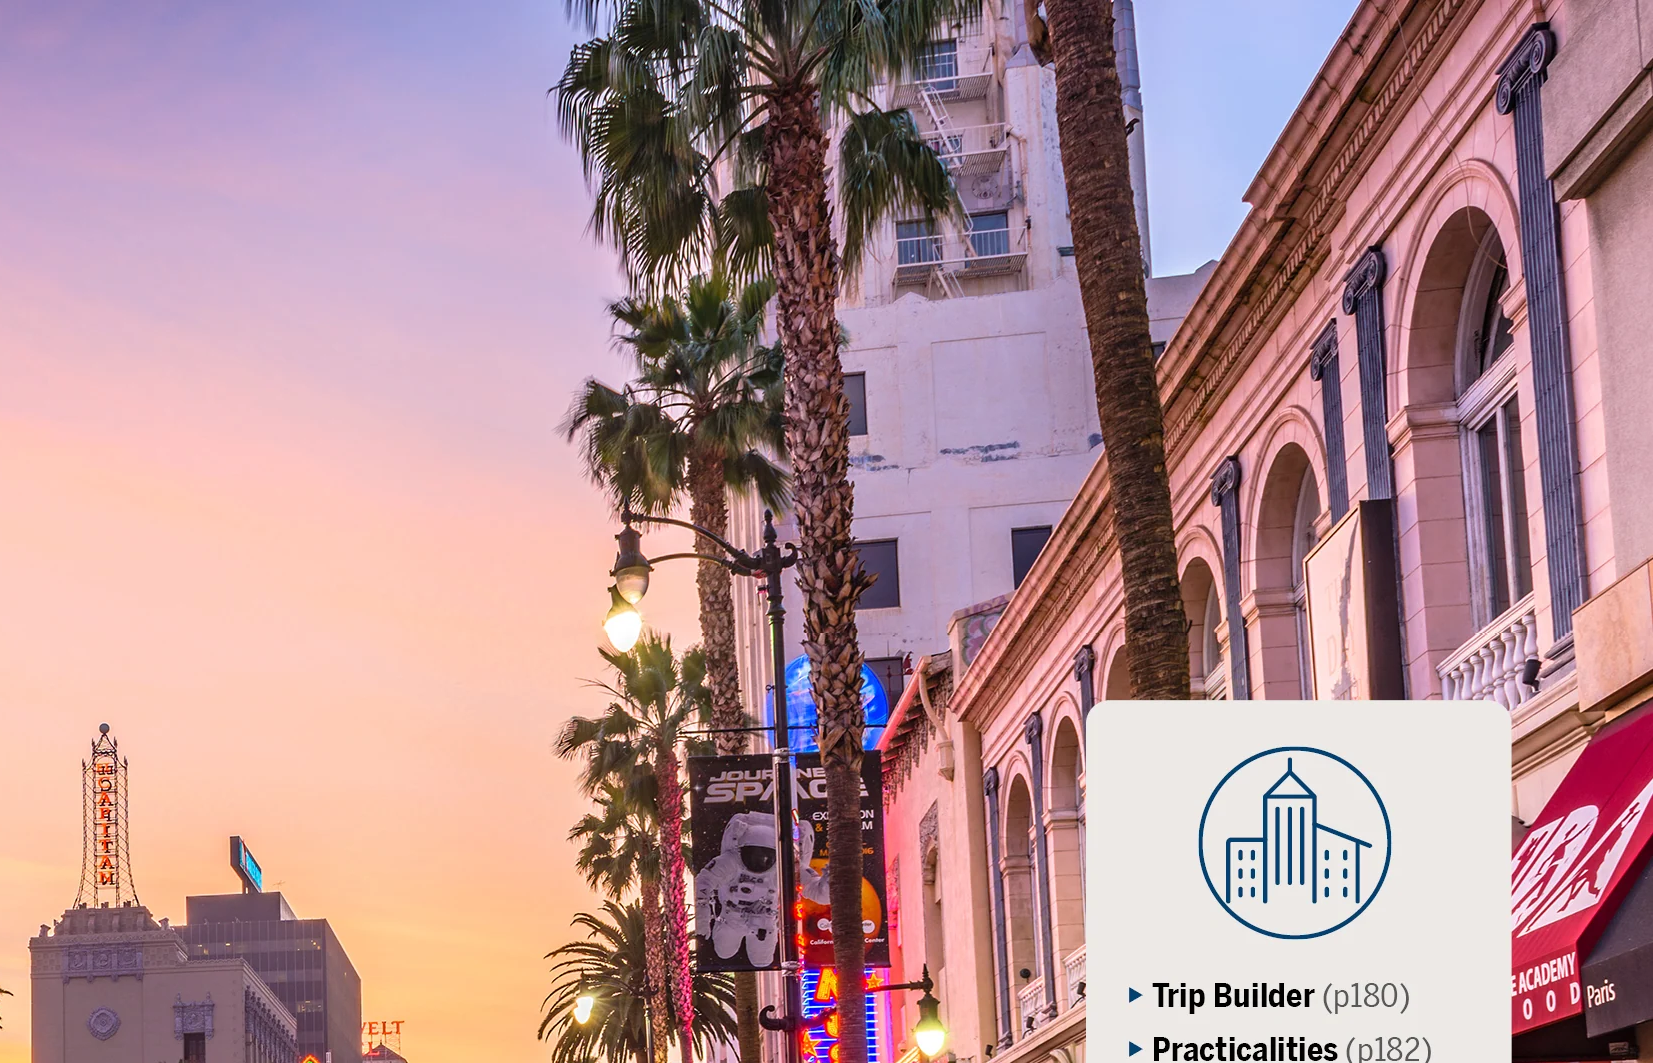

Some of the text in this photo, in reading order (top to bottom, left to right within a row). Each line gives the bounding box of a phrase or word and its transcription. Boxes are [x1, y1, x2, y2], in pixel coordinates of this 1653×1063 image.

[709, 767, 827, 783] JOURNE
[1518, 951, 1577, 995] ACADEMY
[1586, 979, 1616, 1008] Paris
